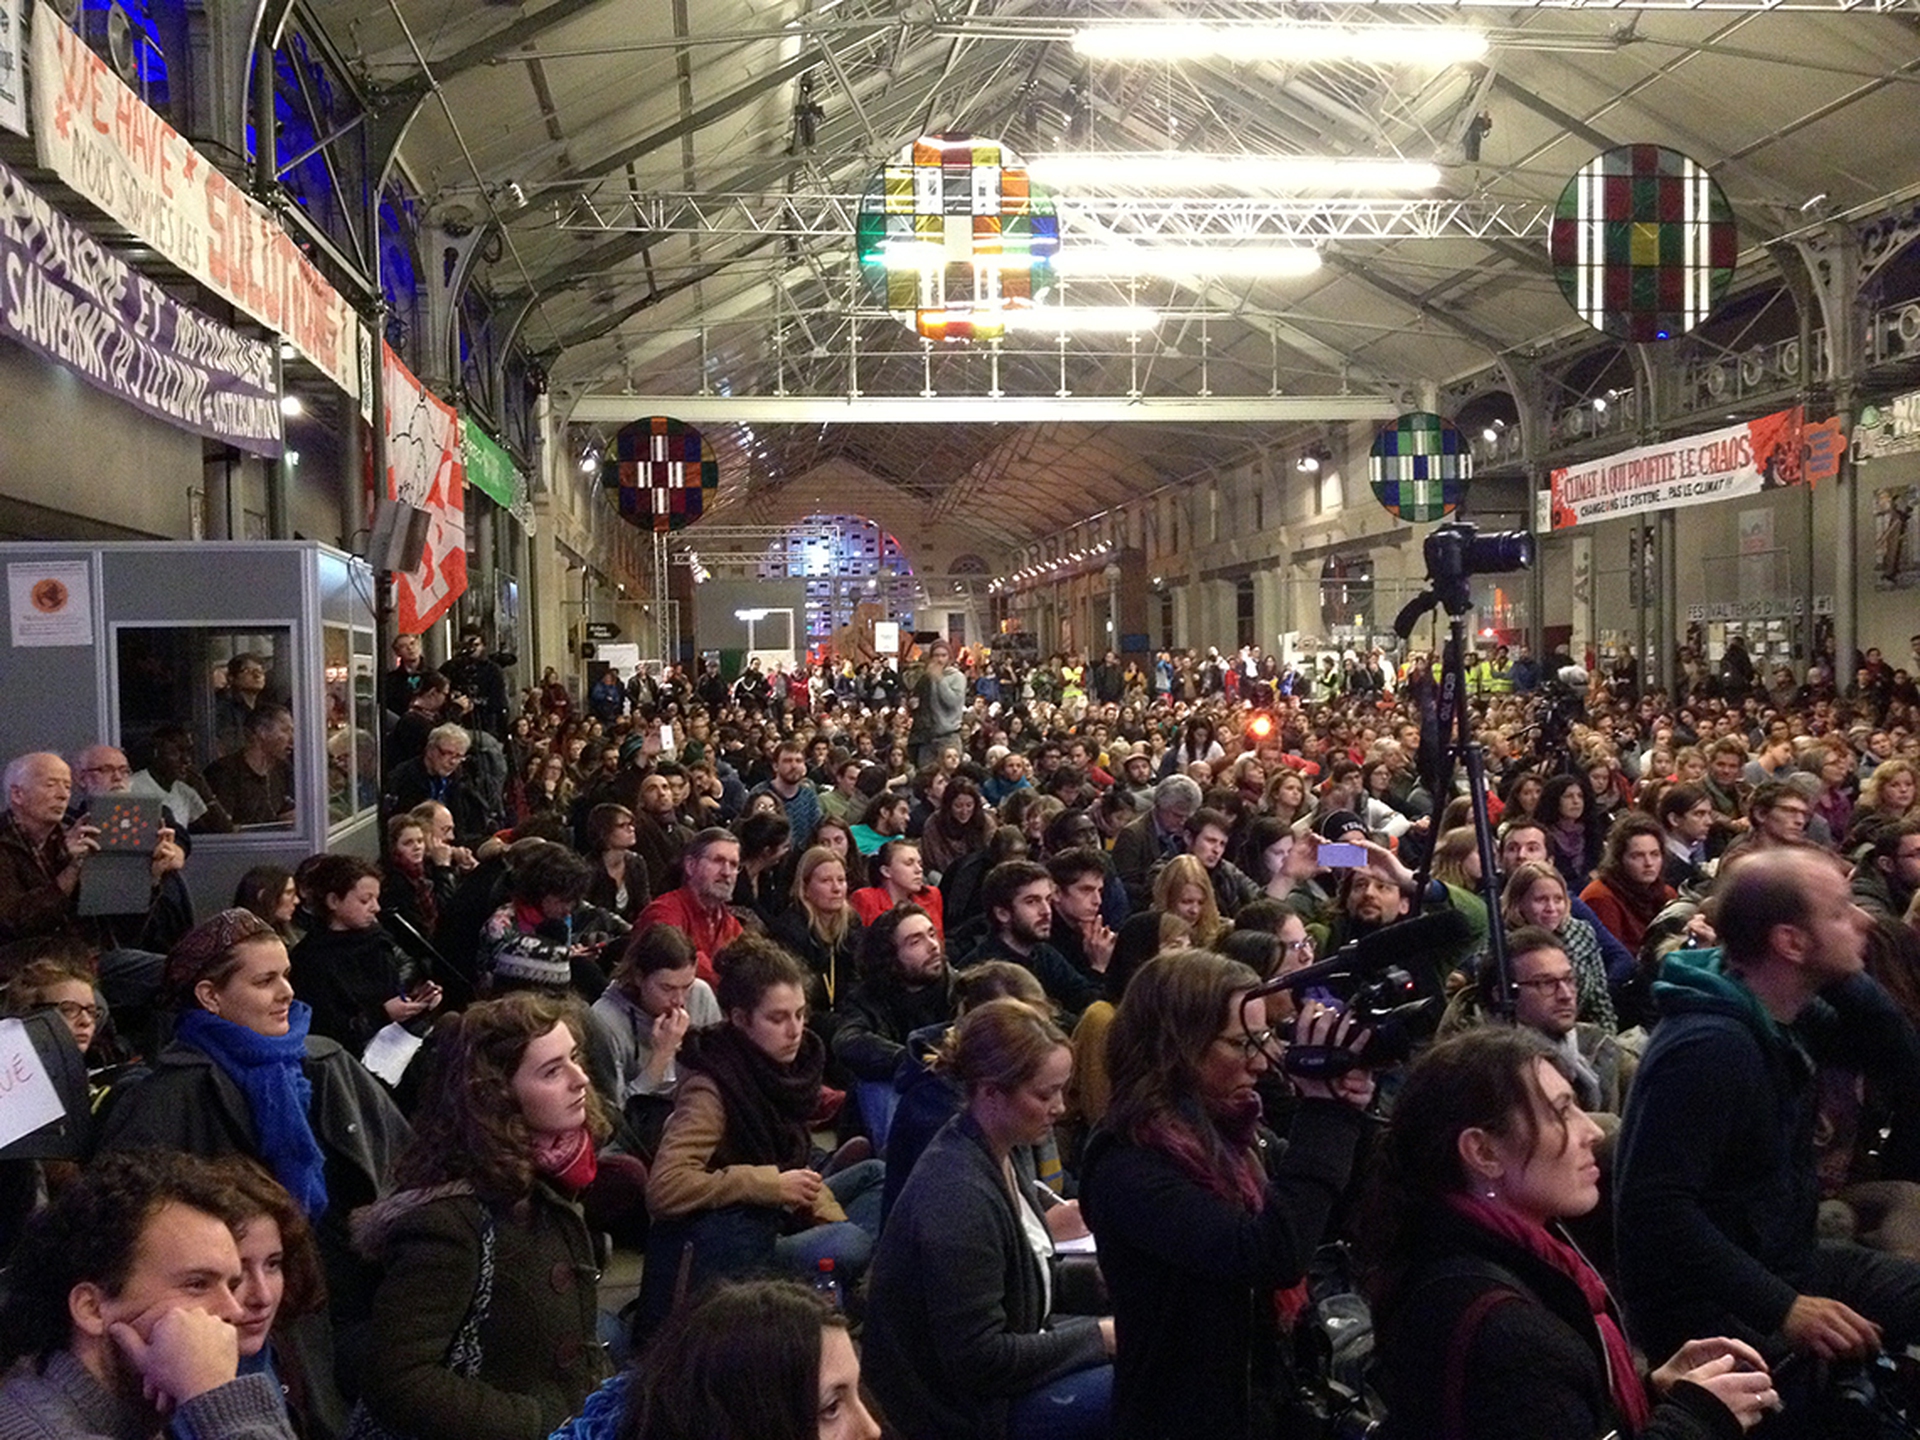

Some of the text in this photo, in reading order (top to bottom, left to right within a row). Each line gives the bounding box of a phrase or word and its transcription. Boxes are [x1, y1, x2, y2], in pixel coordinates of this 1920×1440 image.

[57, 20, 109, 136] WE
[114, 78, 178, 200] HAVE
[71, 127, 200, 271] NOUS SOMMES LES
[1678, 448, 1697, 479] LE
[1698, 434, 1752, 475] CHAOS
